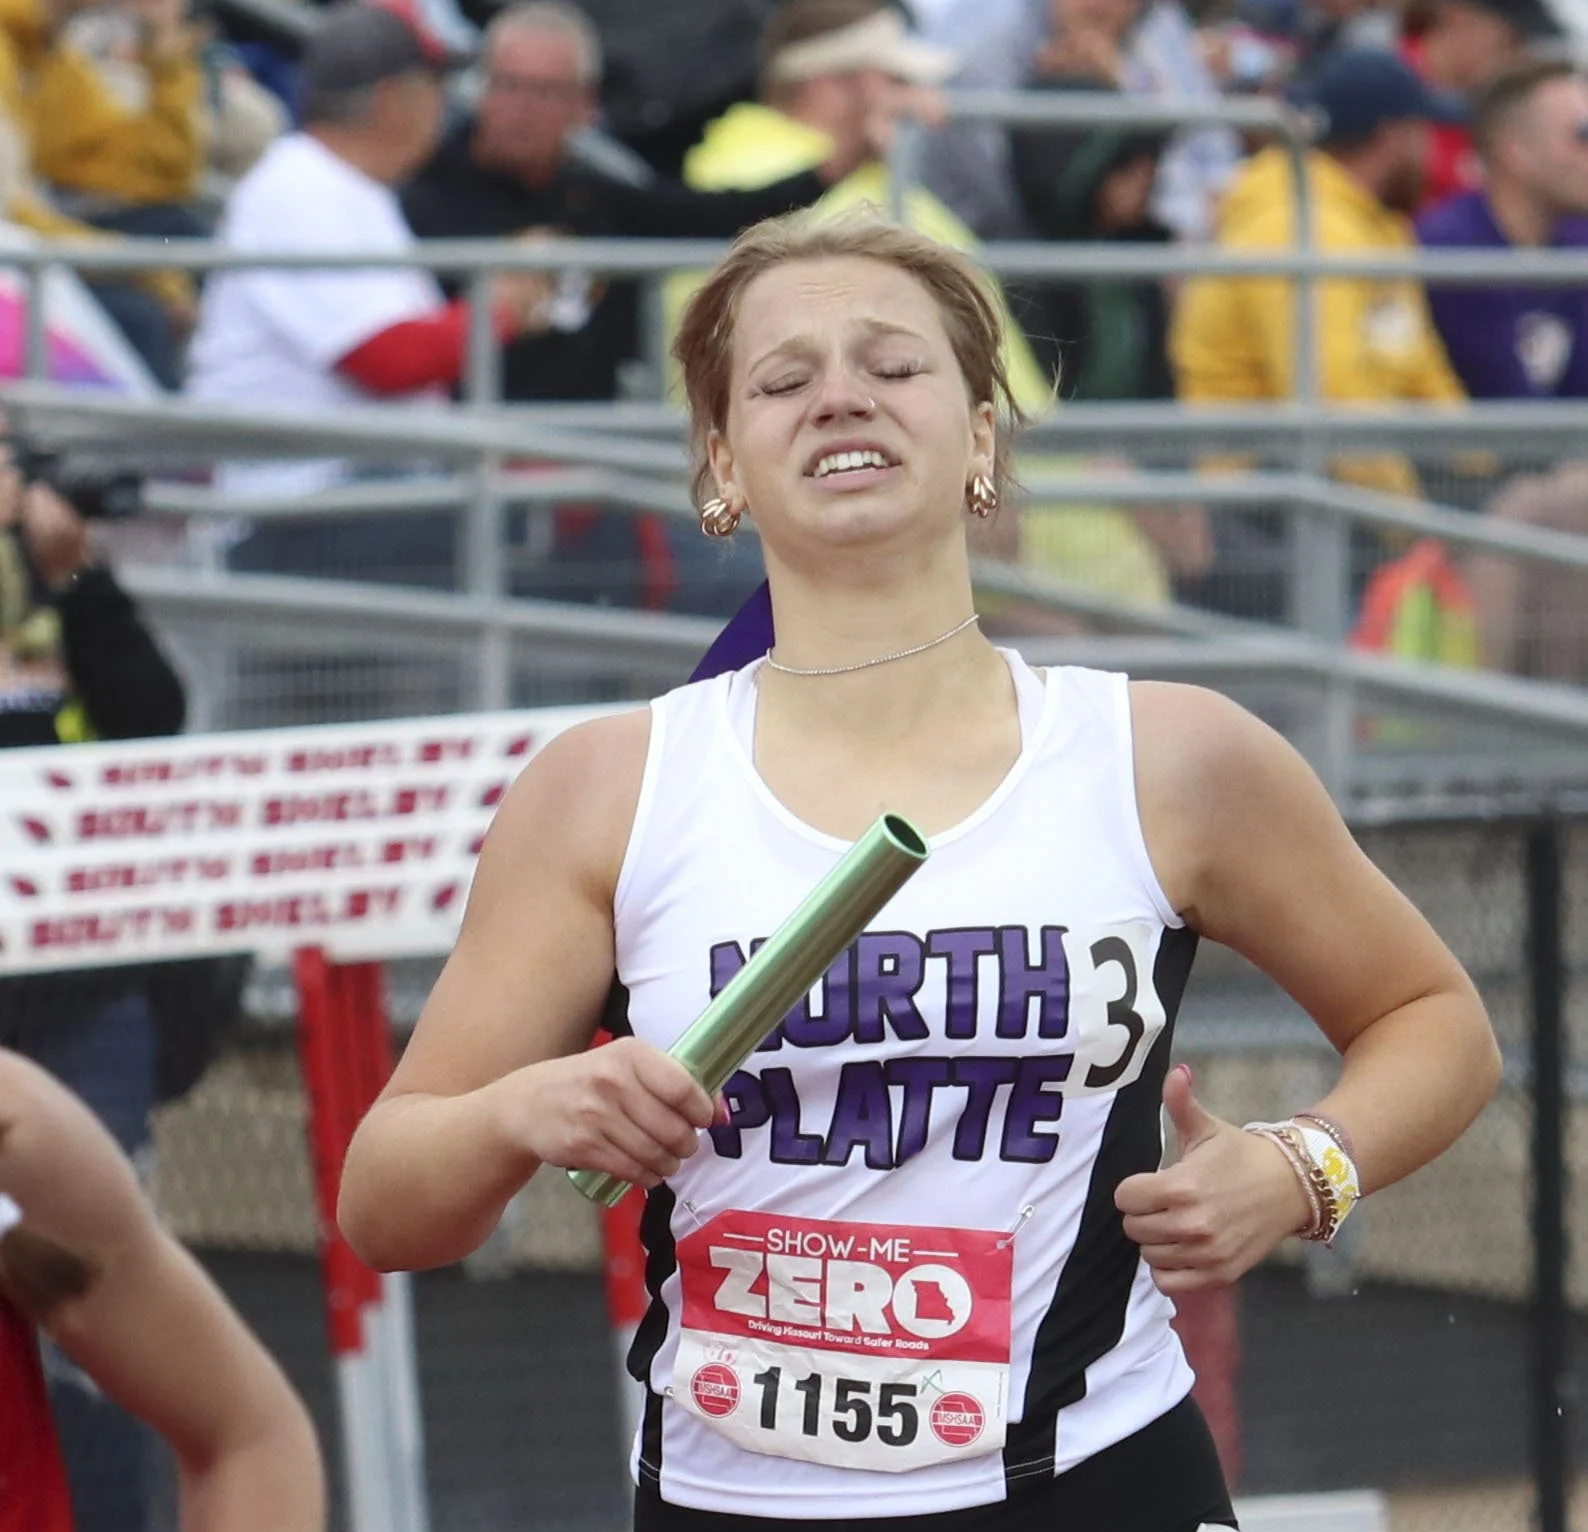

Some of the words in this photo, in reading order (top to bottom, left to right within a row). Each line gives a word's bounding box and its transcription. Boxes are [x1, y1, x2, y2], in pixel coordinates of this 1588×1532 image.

[102, 752, 265, 787] SOUTH
[284, 737, 474, 772] SHELBY
[76, 801, 241, 840] SOUTH
[264, 782, 448, 827] SHELBY
[66, 856, 230, 892] SOUTH
[251, 836, 436, 876] SHELBY
[30, 904, 194, 949] SOUTH
[216, 886, 401, 931] SHELBY
[1085, 935, 1145, 1088] 3
[707, 1053, 1075, 1169] PLATTE
[767, 1228, 911, 1263] SHOW-ME
[709, 1246, 973, 1339] ZERO
[748, 1319, 782, 1337] Driving
[783, 1326, 822, 1342] Missouri
[823, 1331, 862, 1345] Toward
[863, 1336, 893, 1349] Safer
[895, 1339, 930, 1351] Roads
[753, 1366, 919, 1447] 1155
